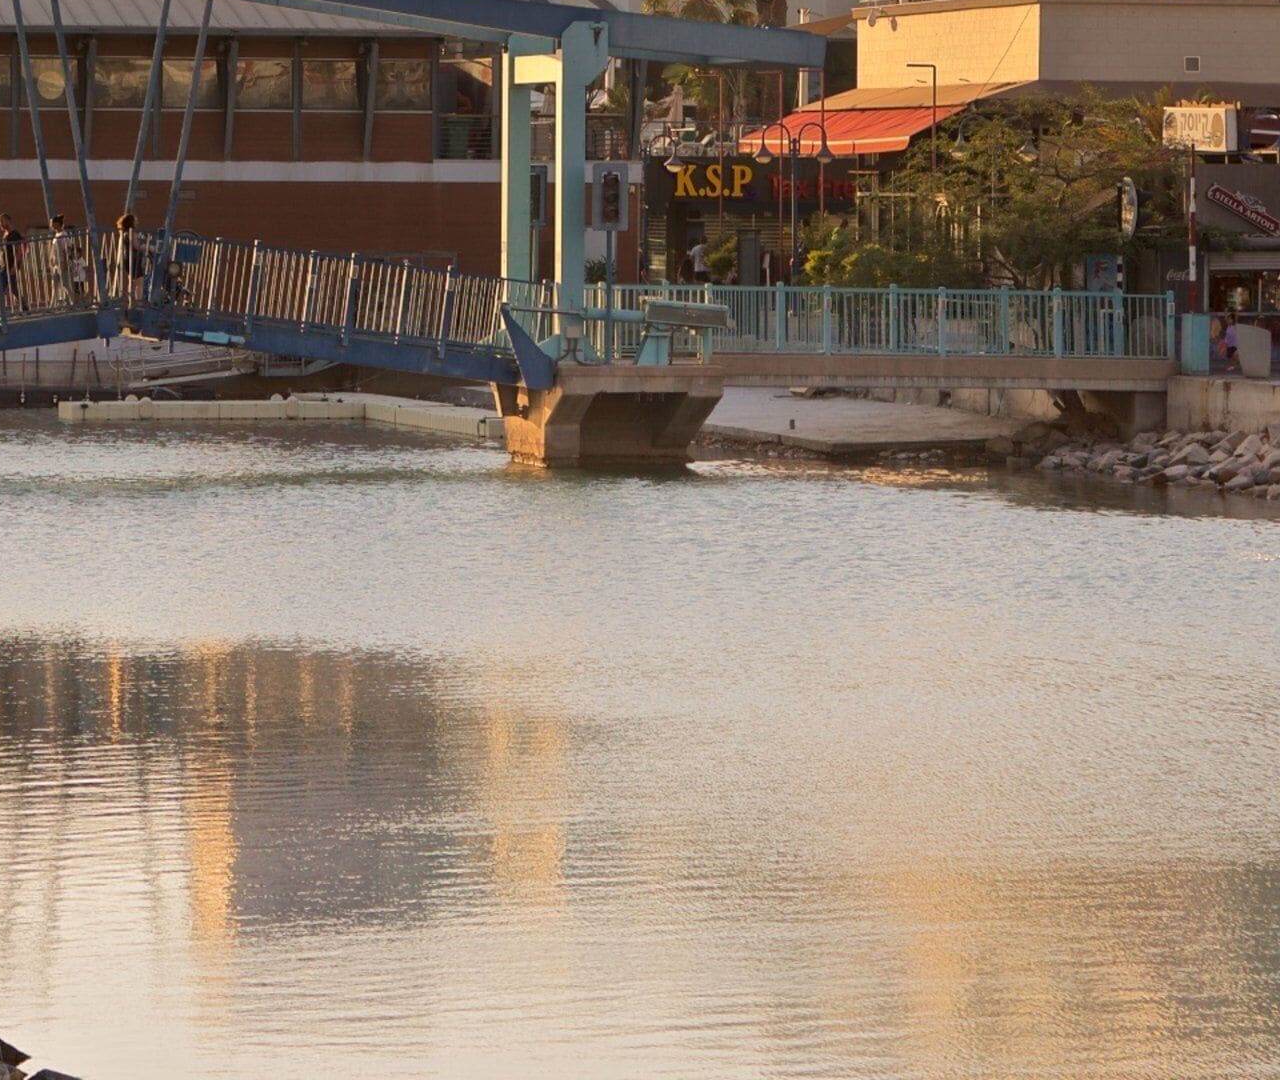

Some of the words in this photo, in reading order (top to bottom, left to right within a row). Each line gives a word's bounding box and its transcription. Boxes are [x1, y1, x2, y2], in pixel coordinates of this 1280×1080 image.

[674, 164, 753, 197] K.S.P
[1214, 191, 1243, 214] STELLA
[1244, 210, 1275, 231] ARTOIS
